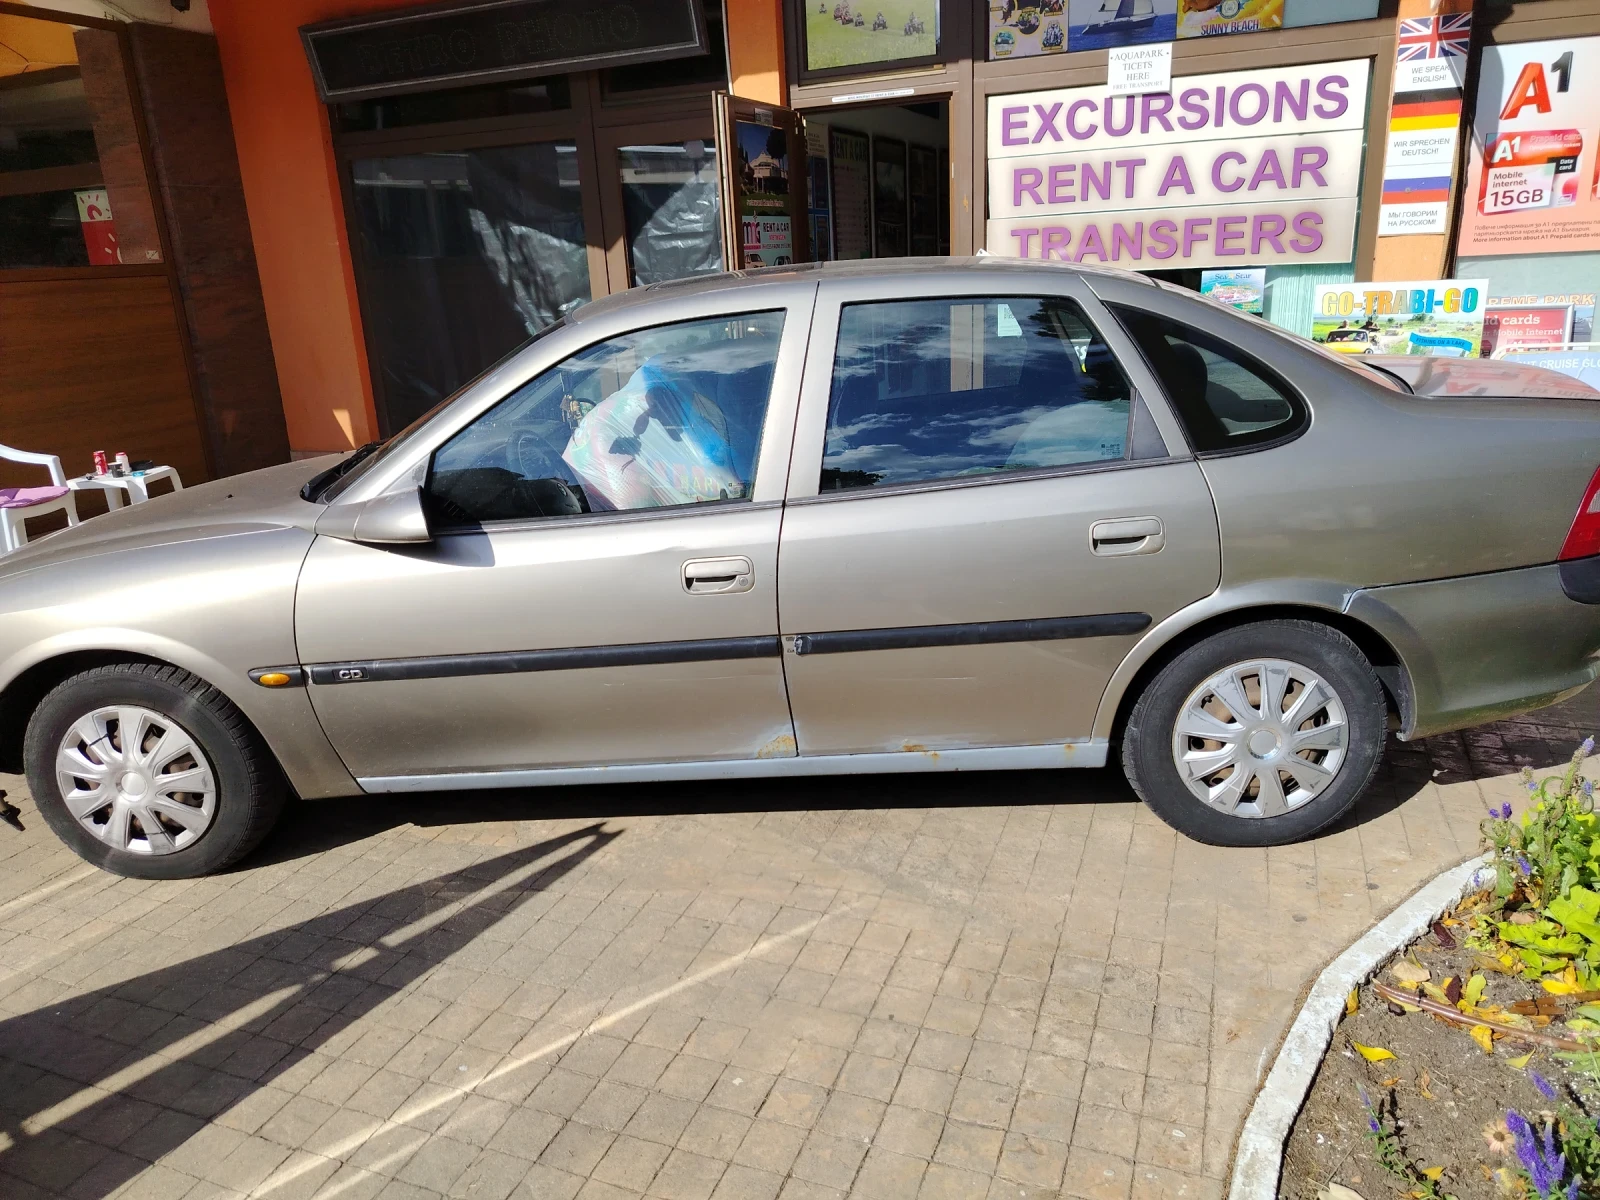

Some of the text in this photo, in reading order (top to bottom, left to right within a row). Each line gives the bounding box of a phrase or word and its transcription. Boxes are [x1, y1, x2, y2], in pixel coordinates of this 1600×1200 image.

[1201, 20, 1259, 36] SUNNY BEACH
[1114, 49, 1164, 61] AQUAPARK
[1123, 61, 1153, 71] TICETS
[1425, 64, 1451, 73] SPEAK
[1126, 72, 1150, 81] HERE
[1412, 74, 1447, 84] ENGLISH!
[1499, 51, 1574, 120] A1
[1002, 75, 1349, 147] EXCURSIONS
[1394, 138, 1449, 148] WIR SPRECHEN
[1402, 148, 1439, 157] DEUTSCH!
[1491, 136, 1521, 164] A1
[1013, 146, 1329, 206] RENT A CAR
[1493, 171, 1524, 180] Mobile
[1492, 179, 1528, 188] internet
[1490, 188, 1544, 208] 15GB
[1388, 210, 1438, 219] МЫ ГОВОРИМ
[1399, 218, 1437, 226] РУССКОМ!
[1011, 212, 1324, 263] TRANSFERS
[1235, 272, 1252, 280] Star
[1321, 287, 1479, 316] GO-TRABI-GO
[1488, 293, 1595, 305] REME PARK
[1485, 314, 1541, 325] id cards
[1493, 329, 1524, 337] Mobile
[1526, 328, 1563, 336] Internet
[1539, 358, 1580, 369] CRUISE
[338, 668, 363, 680] CD
